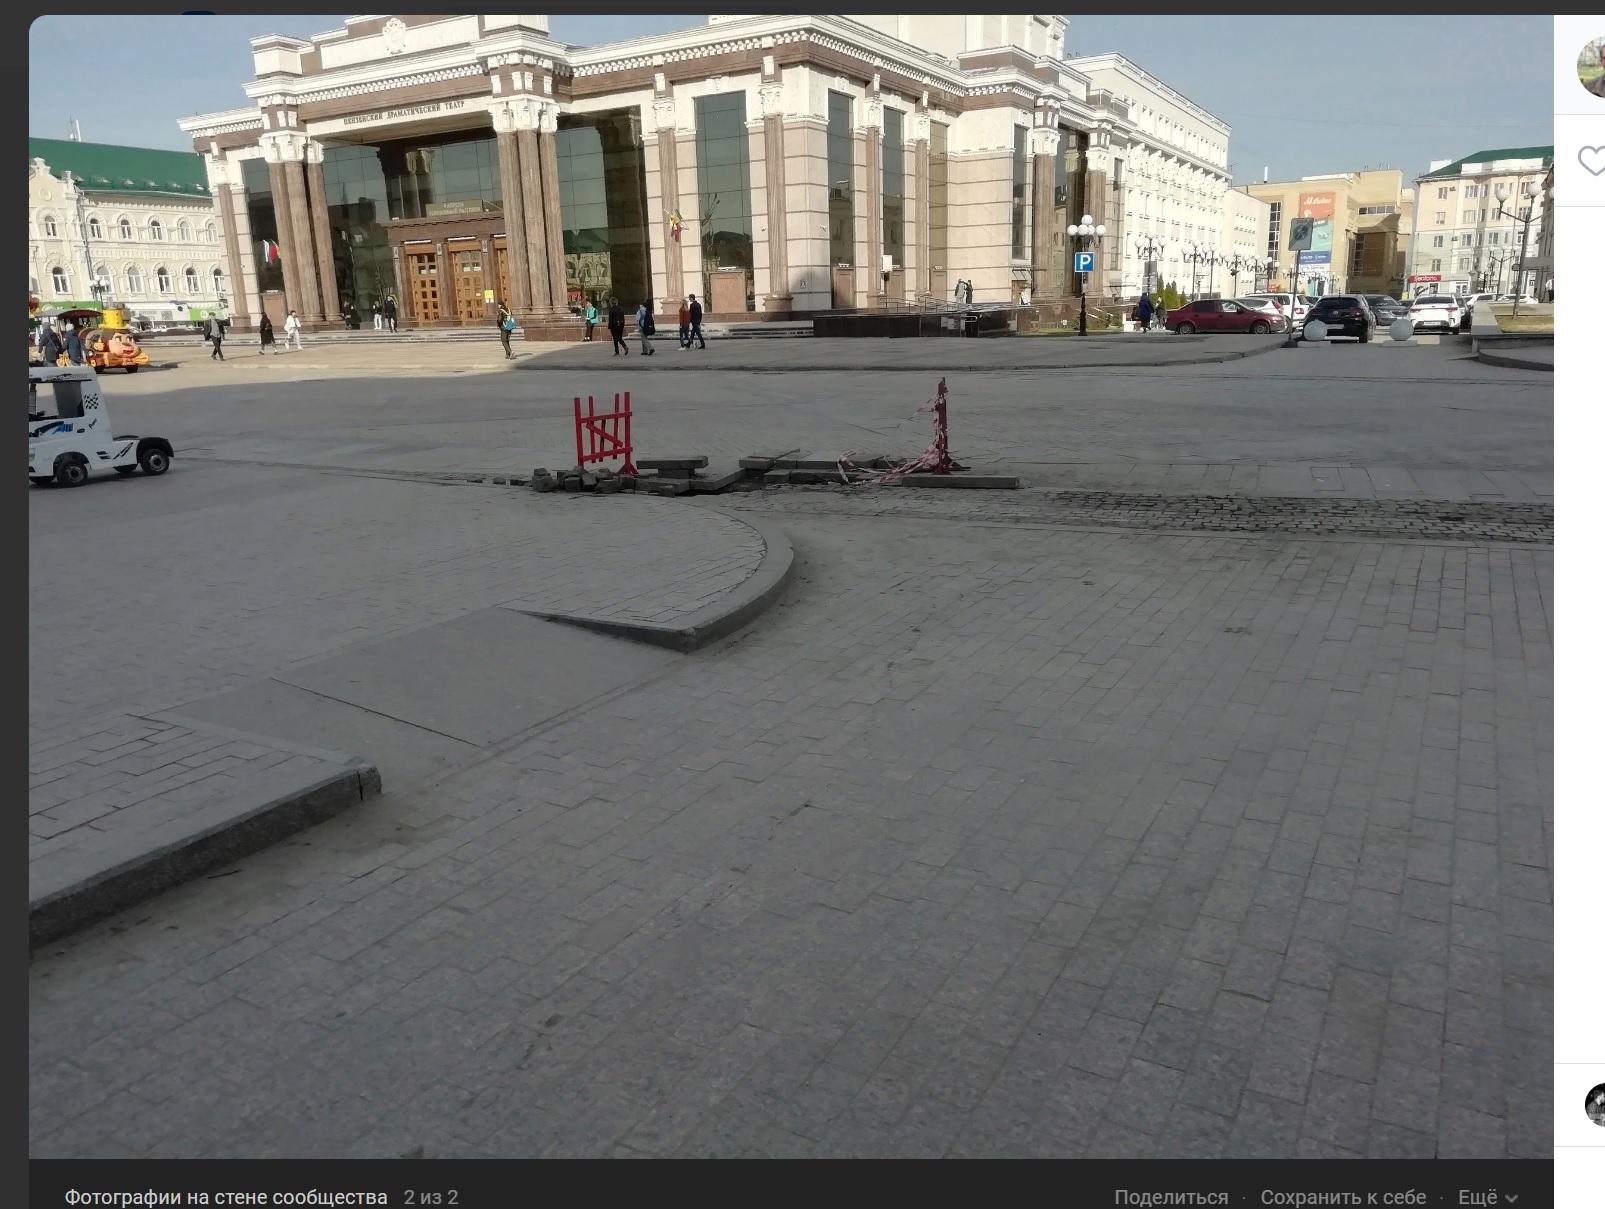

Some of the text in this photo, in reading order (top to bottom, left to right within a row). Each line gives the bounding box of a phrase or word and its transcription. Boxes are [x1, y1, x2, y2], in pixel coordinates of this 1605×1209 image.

[387, 104, 441, 119] ДРАМАТИЧЕСКИЙ
[445, 101, 465, 110] ТЕАТР
[1080, 254, 1091, 270] P
